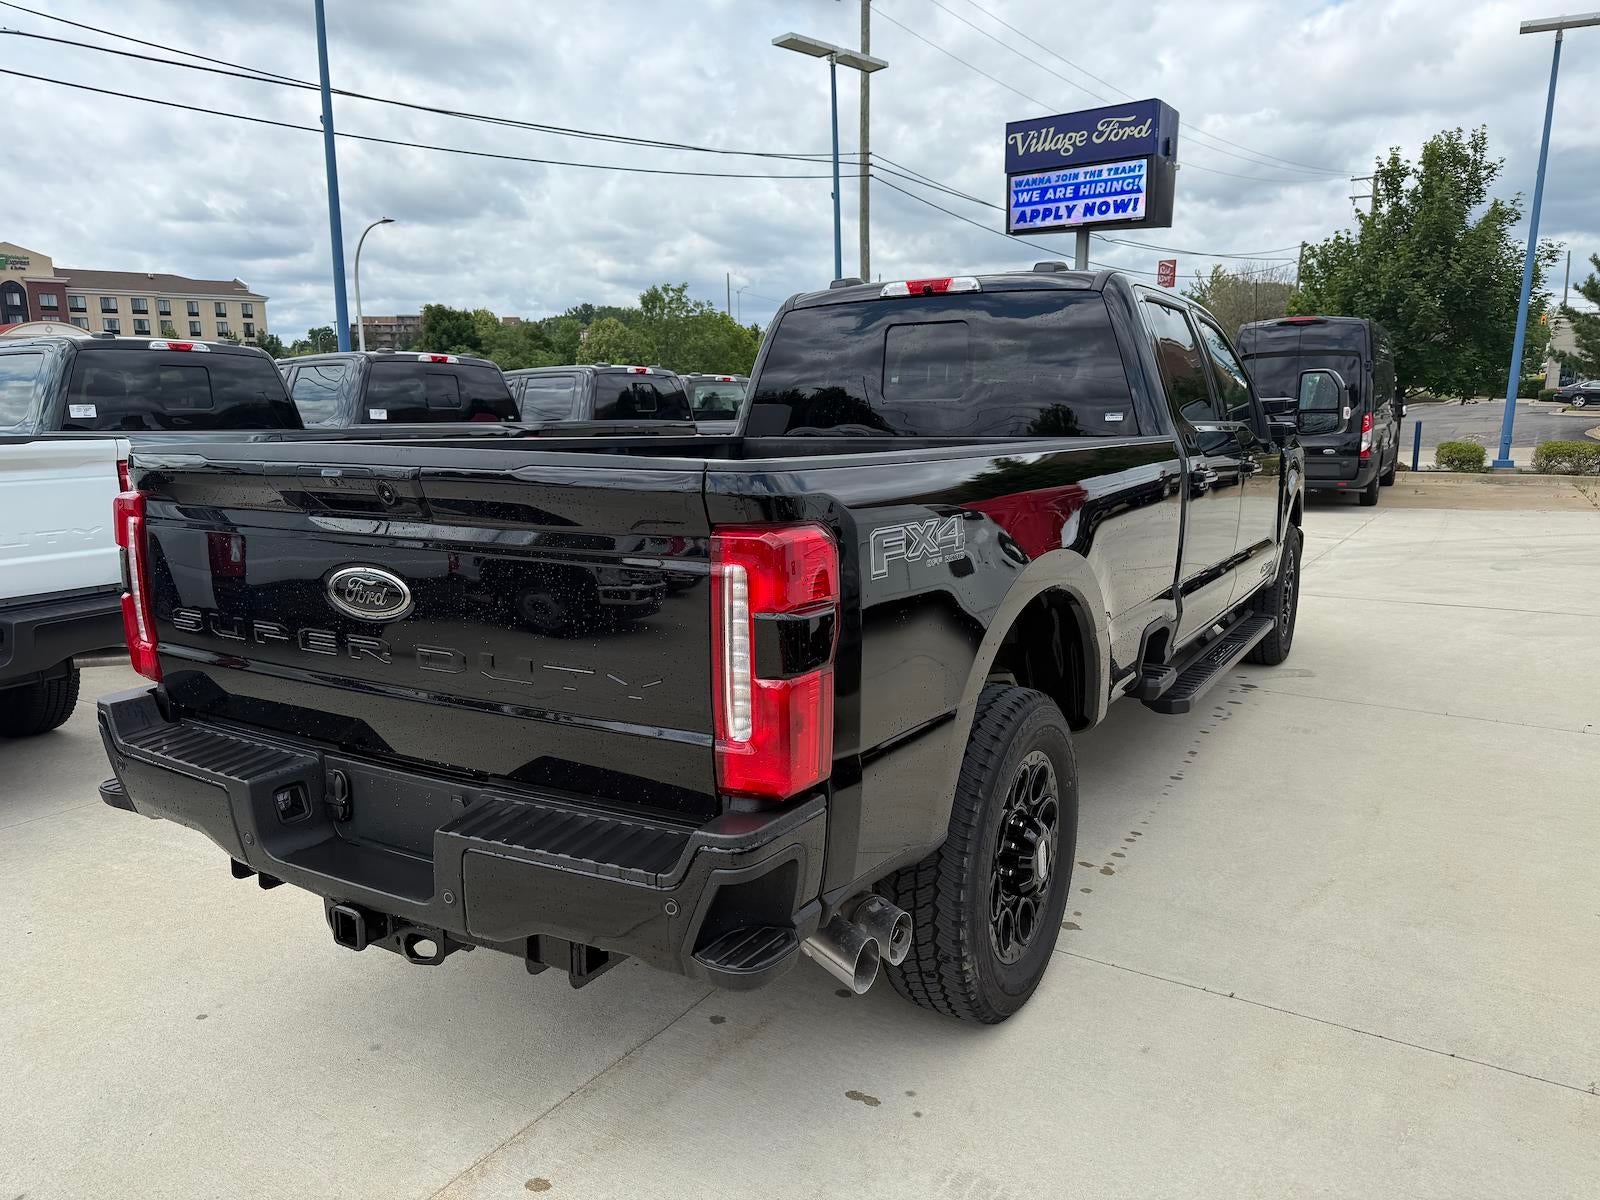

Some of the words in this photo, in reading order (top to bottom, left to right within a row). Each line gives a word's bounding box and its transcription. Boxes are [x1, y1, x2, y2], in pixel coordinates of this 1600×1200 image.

[1008, 127, 1088, 156] Village
[1092, 115, 1152, 144] Ford
[1014, 176, 1051, 189] WANNA
[1055, 173, 1079, 183] JOIN
[1083, 168, 1105, 179] THE
[1107, 164, 1143, 176] TEAM?
[1018, 189, 1041, 203] WE
[1044, 185, 1074, 200] ARE
[1079, 177, 1140, 196] HIRING!
[1015, 204, 1078, 224] APPLY
[1082, 197, 1140, 218] NOW!
[870, 513, 966, 581] FX4
[344, 577, 389, 607] Ford
[173, 606, 393, 665] SUPER
[416, 643, 664, 701] DUTY
